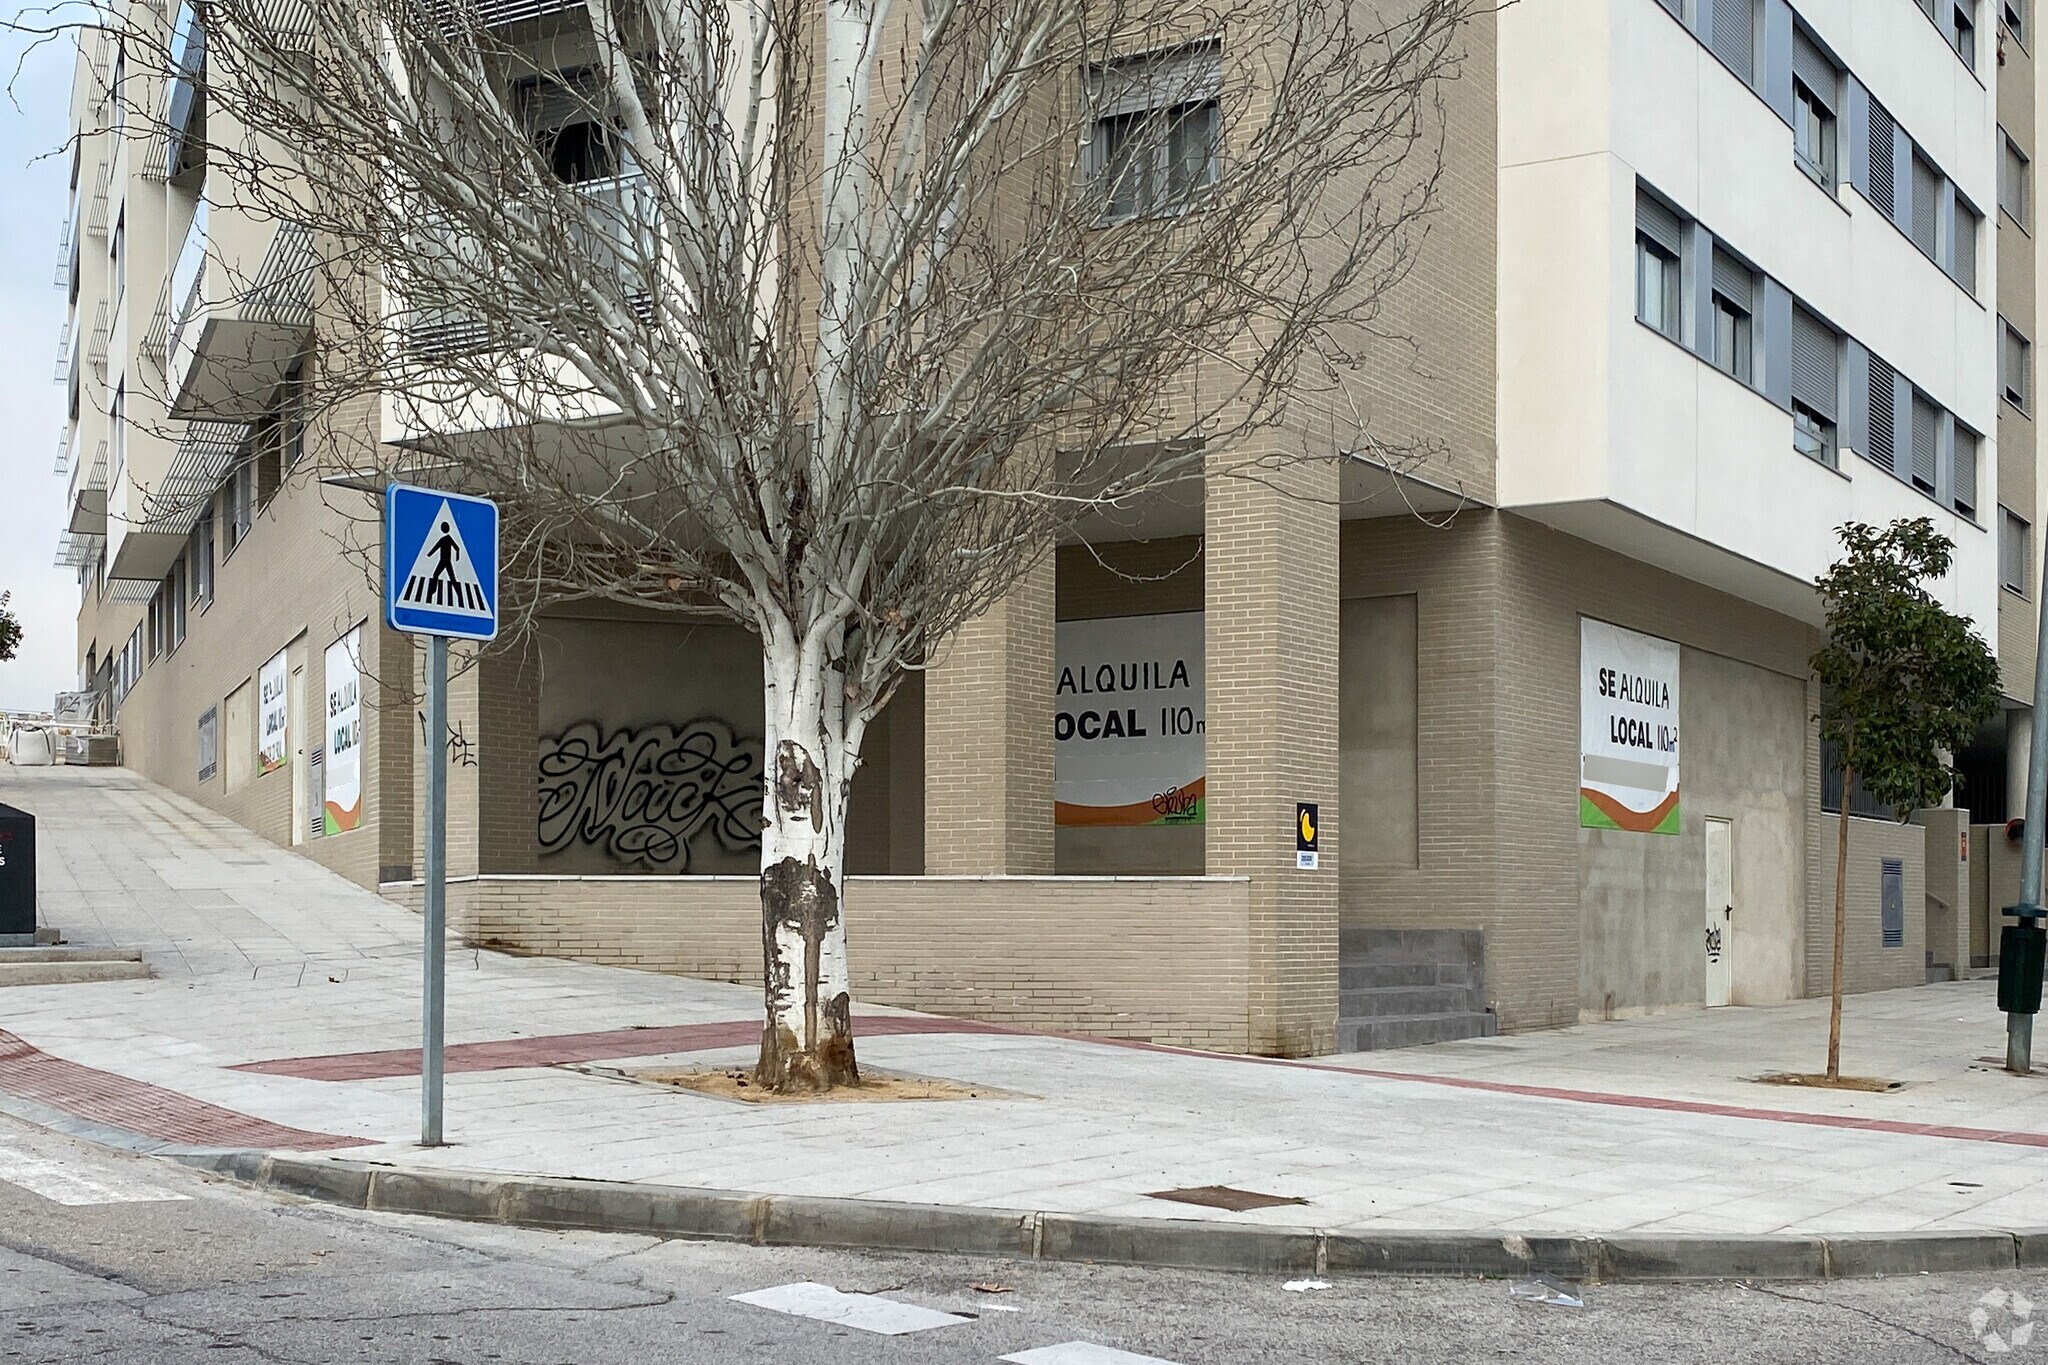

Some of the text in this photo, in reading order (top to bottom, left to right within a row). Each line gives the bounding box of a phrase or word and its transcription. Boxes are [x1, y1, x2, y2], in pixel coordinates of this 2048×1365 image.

[1056, 660, 1190, 695] ALQUILA
[1599, 667, 1669, 710] SE ALQUILA
[1055, 709, 1146, 741] OCAL
[1611, 715, 1653, 749] LOCAL
